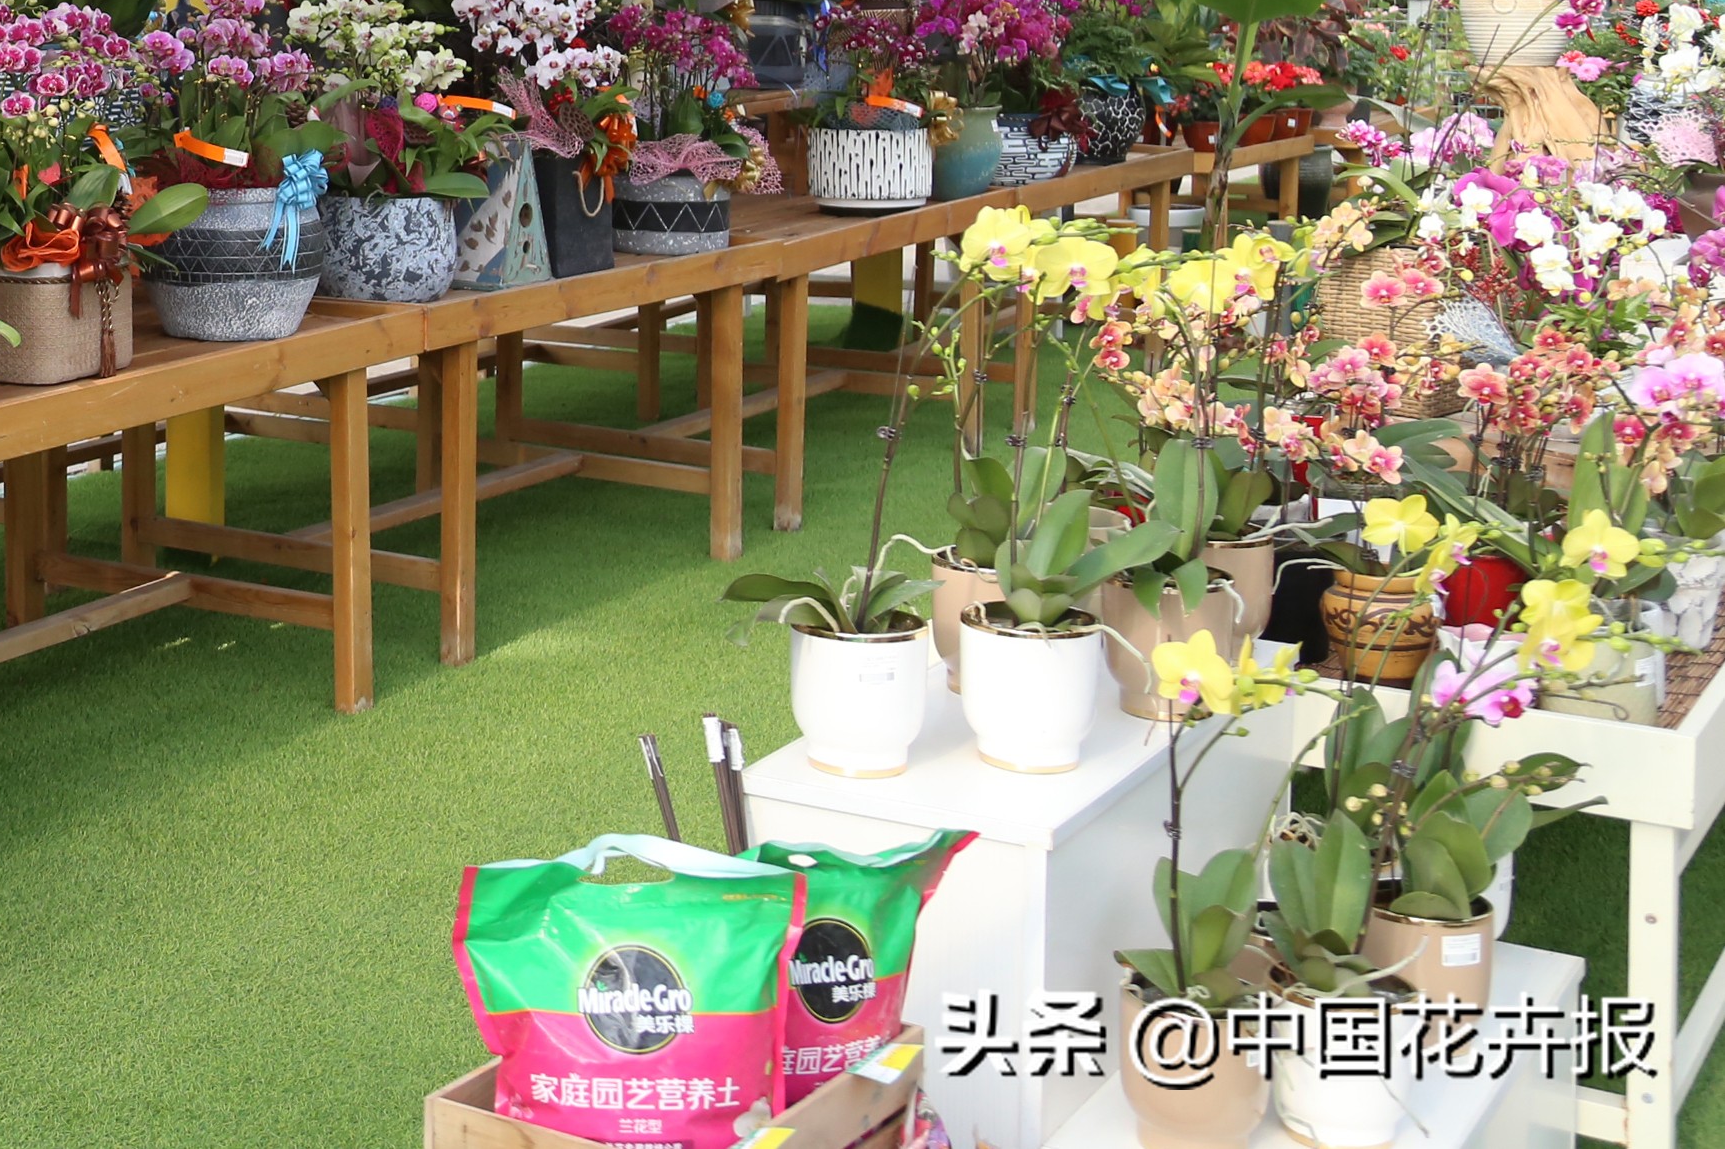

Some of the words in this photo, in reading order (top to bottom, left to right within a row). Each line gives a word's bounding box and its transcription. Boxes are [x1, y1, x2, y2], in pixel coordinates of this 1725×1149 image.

[831, 982, 877, 1004] 美乐棵
[631, 1014, 695, 1034] 美乐棵
[530, 1072, 741, 1111] 家庭园艺营养土
[618, 1117, 663, 1135] 兰花型
